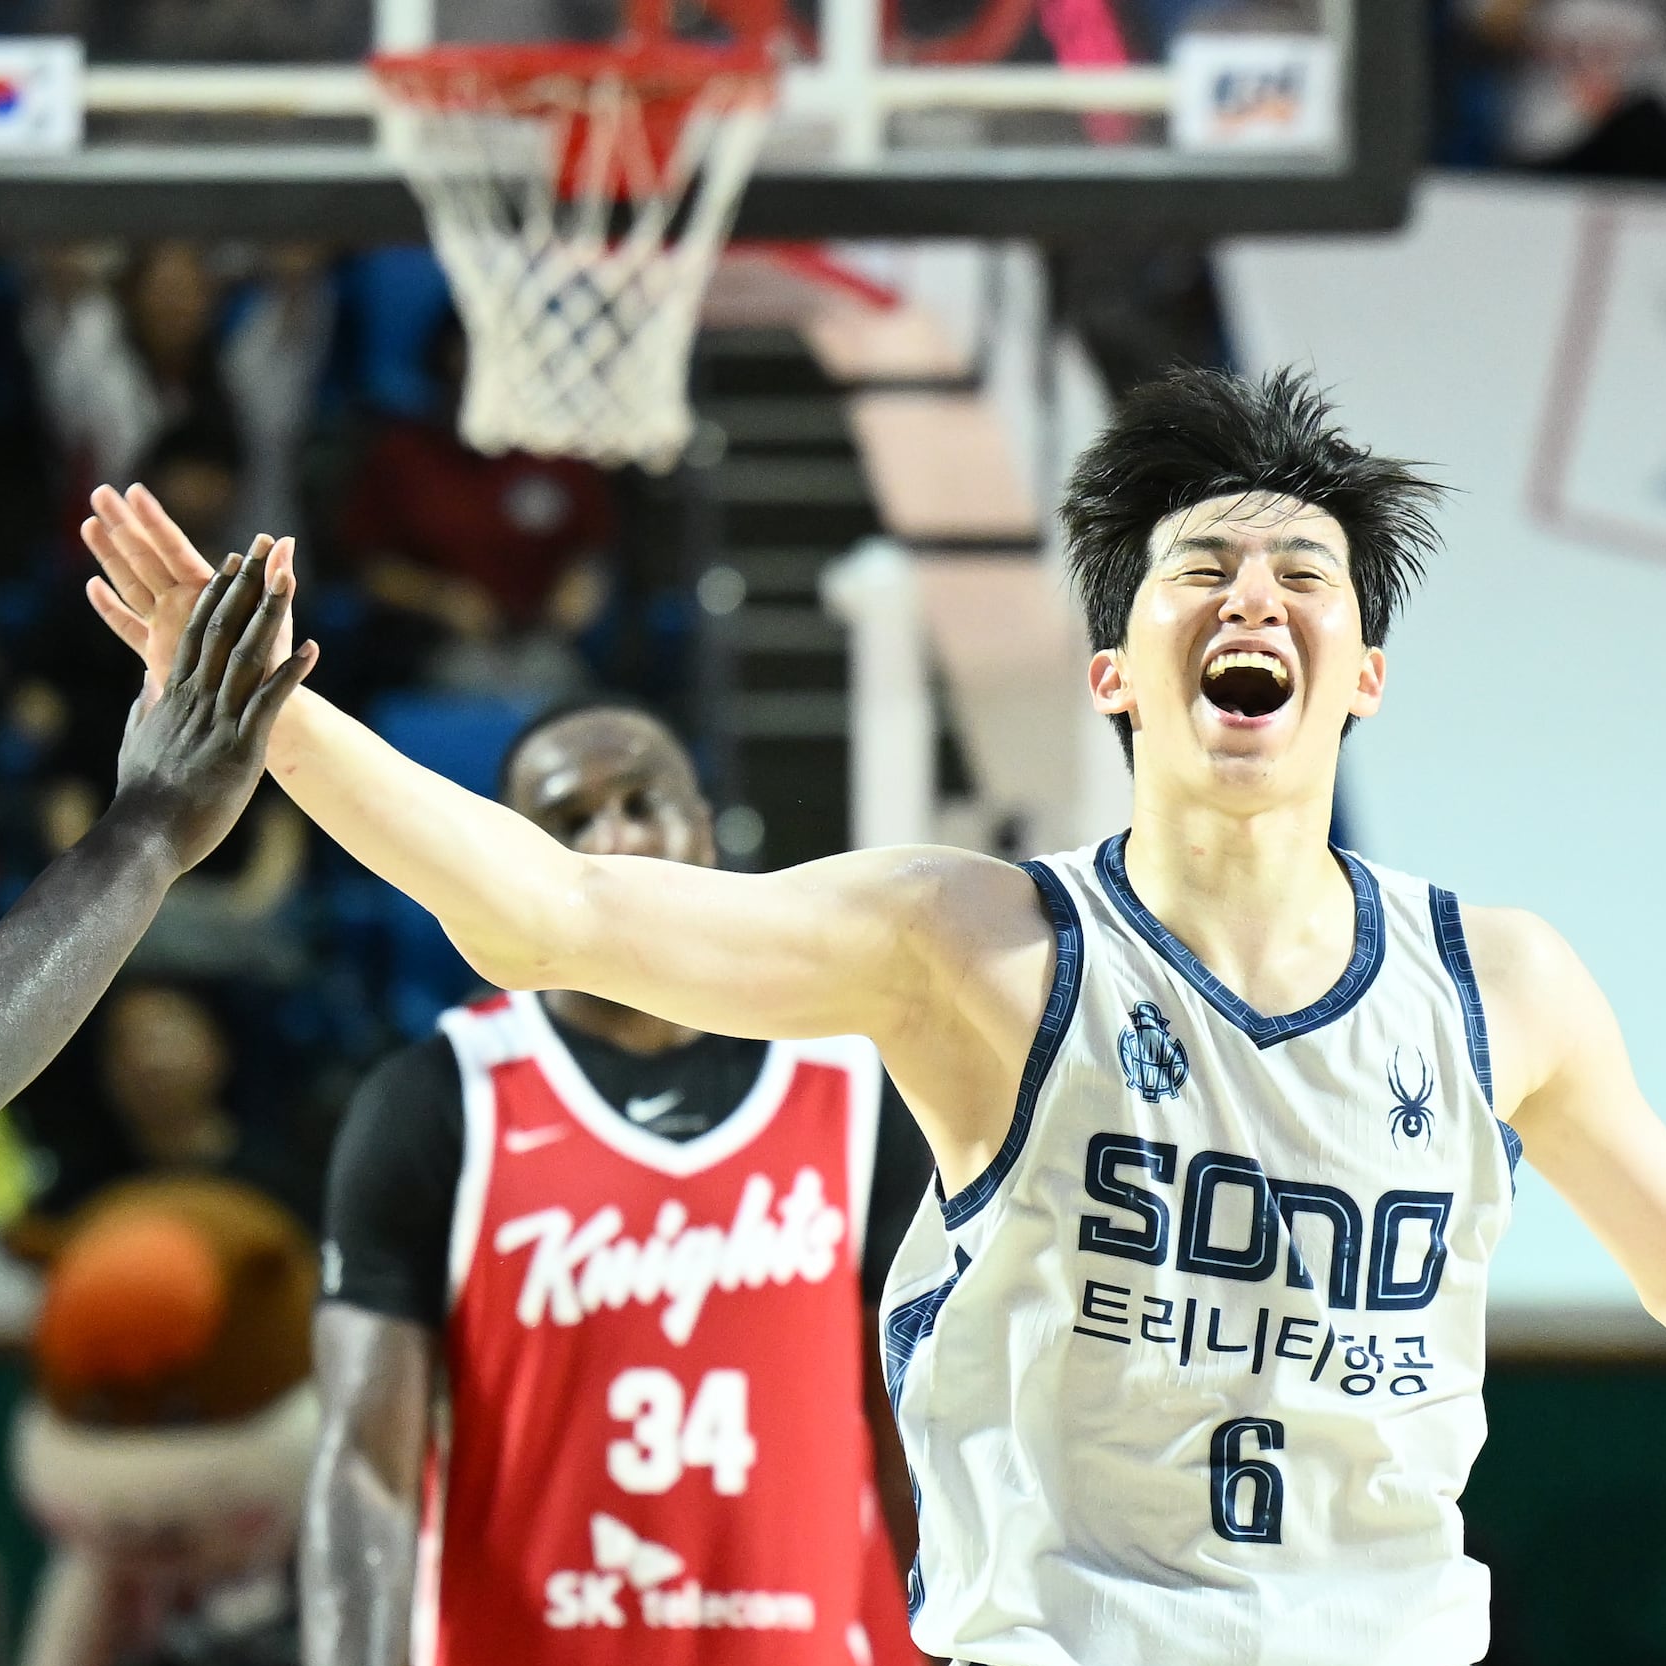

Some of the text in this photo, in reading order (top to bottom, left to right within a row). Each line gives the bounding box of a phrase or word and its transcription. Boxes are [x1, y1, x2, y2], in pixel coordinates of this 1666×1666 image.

[495, 1167, 845, 1347] Knights
[606, 1366, 758, 1496] 34
[1210, 1417, 1285, 1545] 6
[544, 1570, 627, 1629] SK
